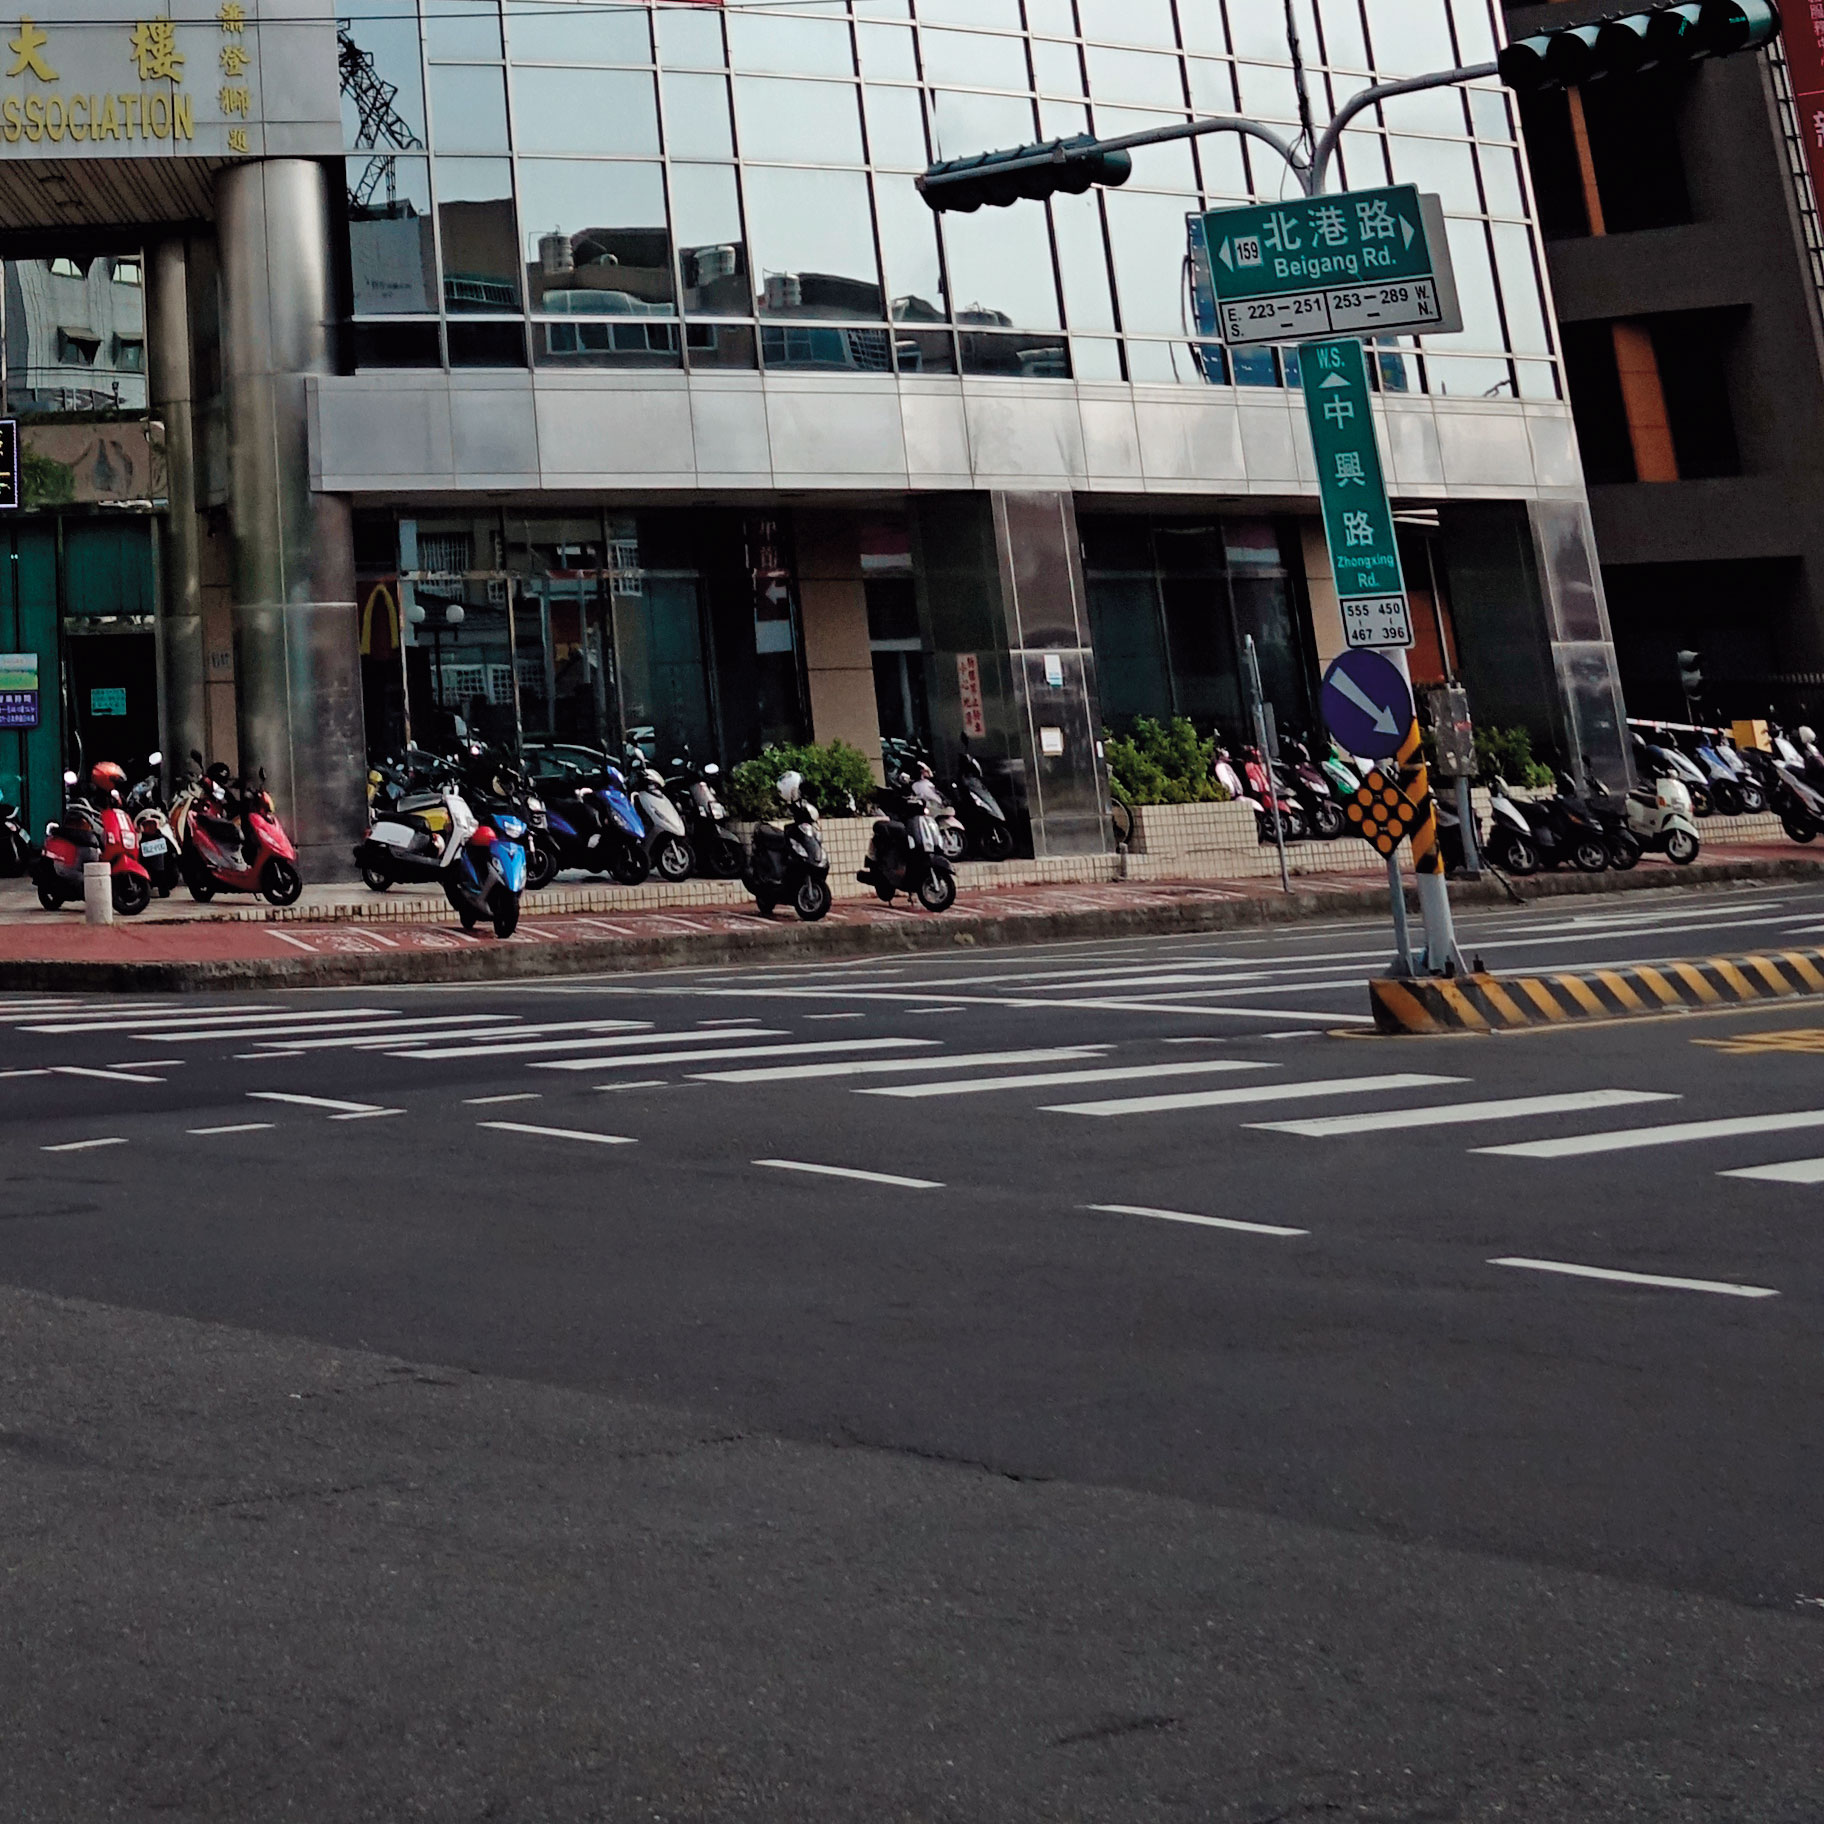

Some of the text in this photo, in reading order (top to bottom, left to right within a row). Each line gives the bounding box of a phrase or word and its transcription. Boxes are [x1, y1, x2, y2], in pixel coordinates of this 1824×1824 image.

[1237, 199, 1396, 260] 159 北港路
[1273, 245, 1396, 279] Beigang Rd.
[1415, 285, 1430, 299] W.
[1228, 308, 1242, 322] E.
[1418, 301, 1433, 316] N.
[1231, 323, 1244, 337] S.
[1316, 347, 1345, 368] W.S.
[1323, 394, 1374, 548] 中興路
[1337, 553, 1395, 570] Zhongxing
[1358, 572, 1379, 587] Rd.
[1347, 603, 1400, 617] 555 450
[1352, 627, 1405, 641] 467 396
